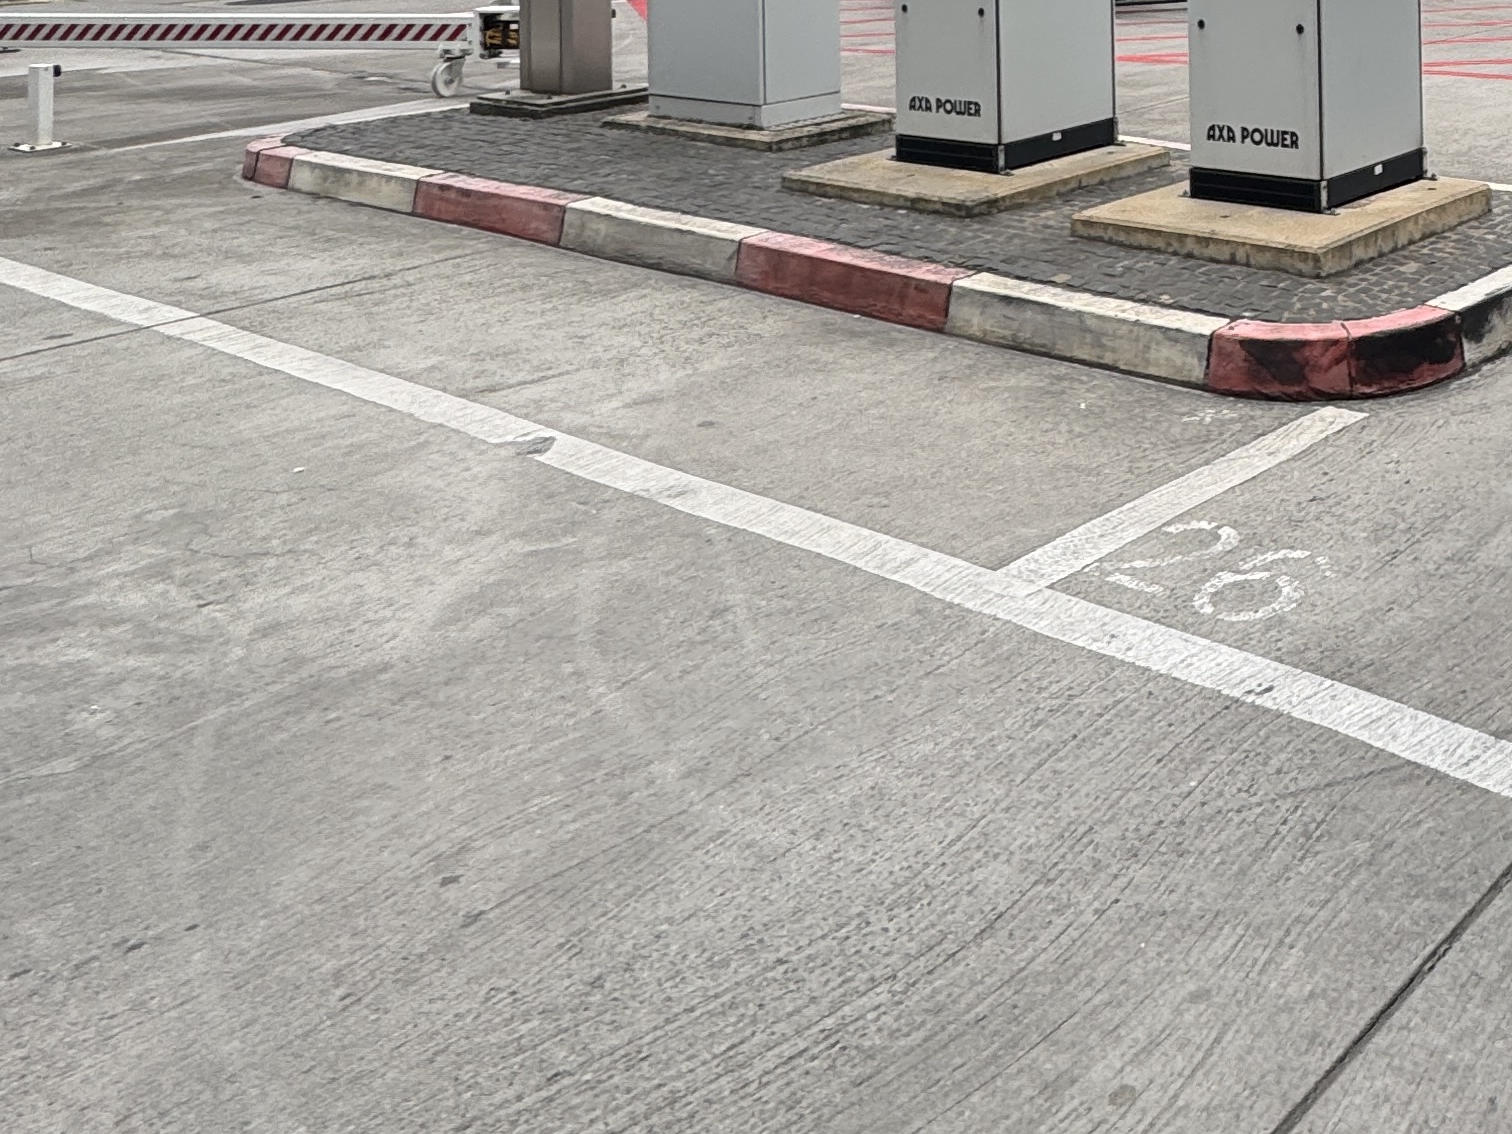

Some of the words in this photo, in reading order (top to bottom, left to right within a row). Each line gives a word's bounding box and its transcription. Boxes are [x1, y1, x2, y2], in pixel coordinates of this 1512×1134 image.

[908, 95, 932, 113] AXA
[935, 97, 982, 118] POWER
[1206, 123, 1236, 143] AXA
[1240, 126, 1299, 150] POWER
